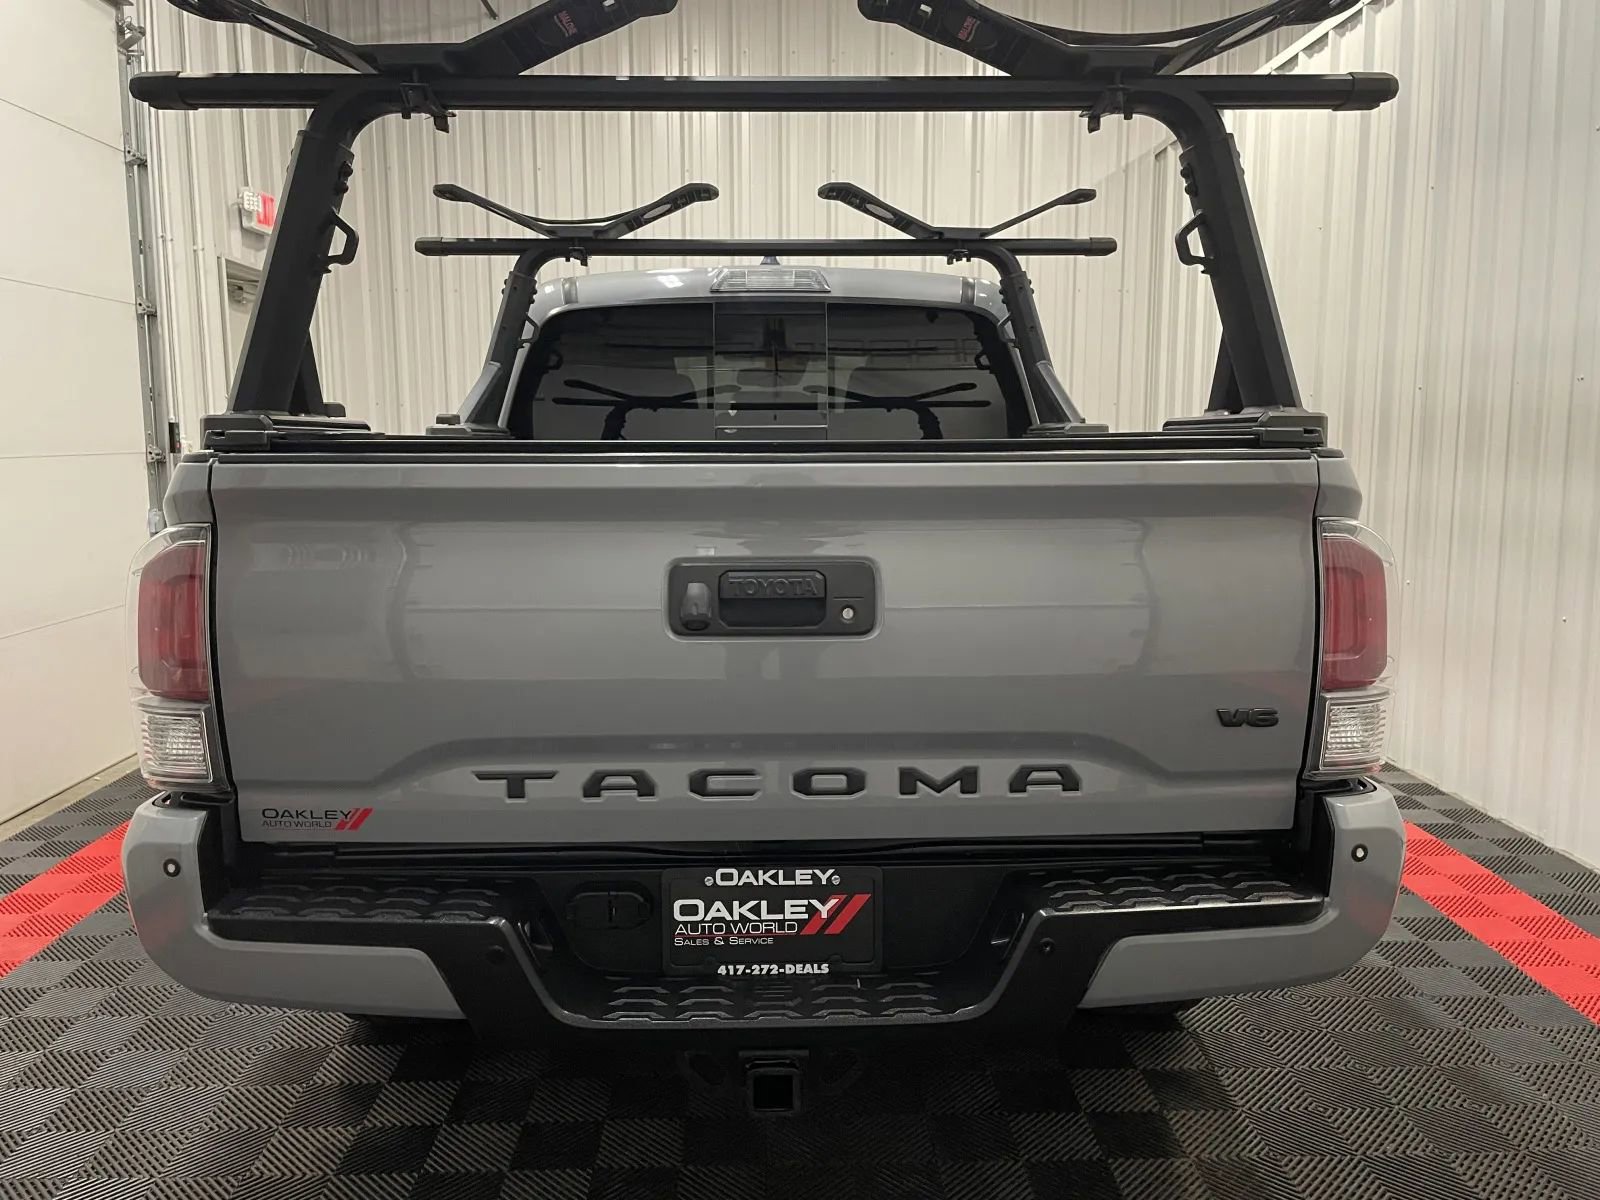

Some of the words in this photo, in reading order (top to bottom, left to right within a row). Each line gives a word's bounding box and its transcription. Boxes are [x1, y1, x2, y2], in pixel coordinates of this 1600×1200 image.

[728, 577, 819, 597] TOYOTA
[1215, 707, 1280, 728] V6
[471, 762, 1083, 802] TACOMA
[261, 808, 352, 820] OAKLEY
[262, 820, 292, 828] AUTO
[293, 820, 332, 828] WORLD
[715, 868, 835, 886] OAKLEY
[673, 899, 840, 922] OAKLEY
[674, 922, 726, 935] AUTO
[730, 921, 798, 935] WORLD
[713, 936, 725, 946] &
[716, 963, 830, 976] 417-272-DEALS
